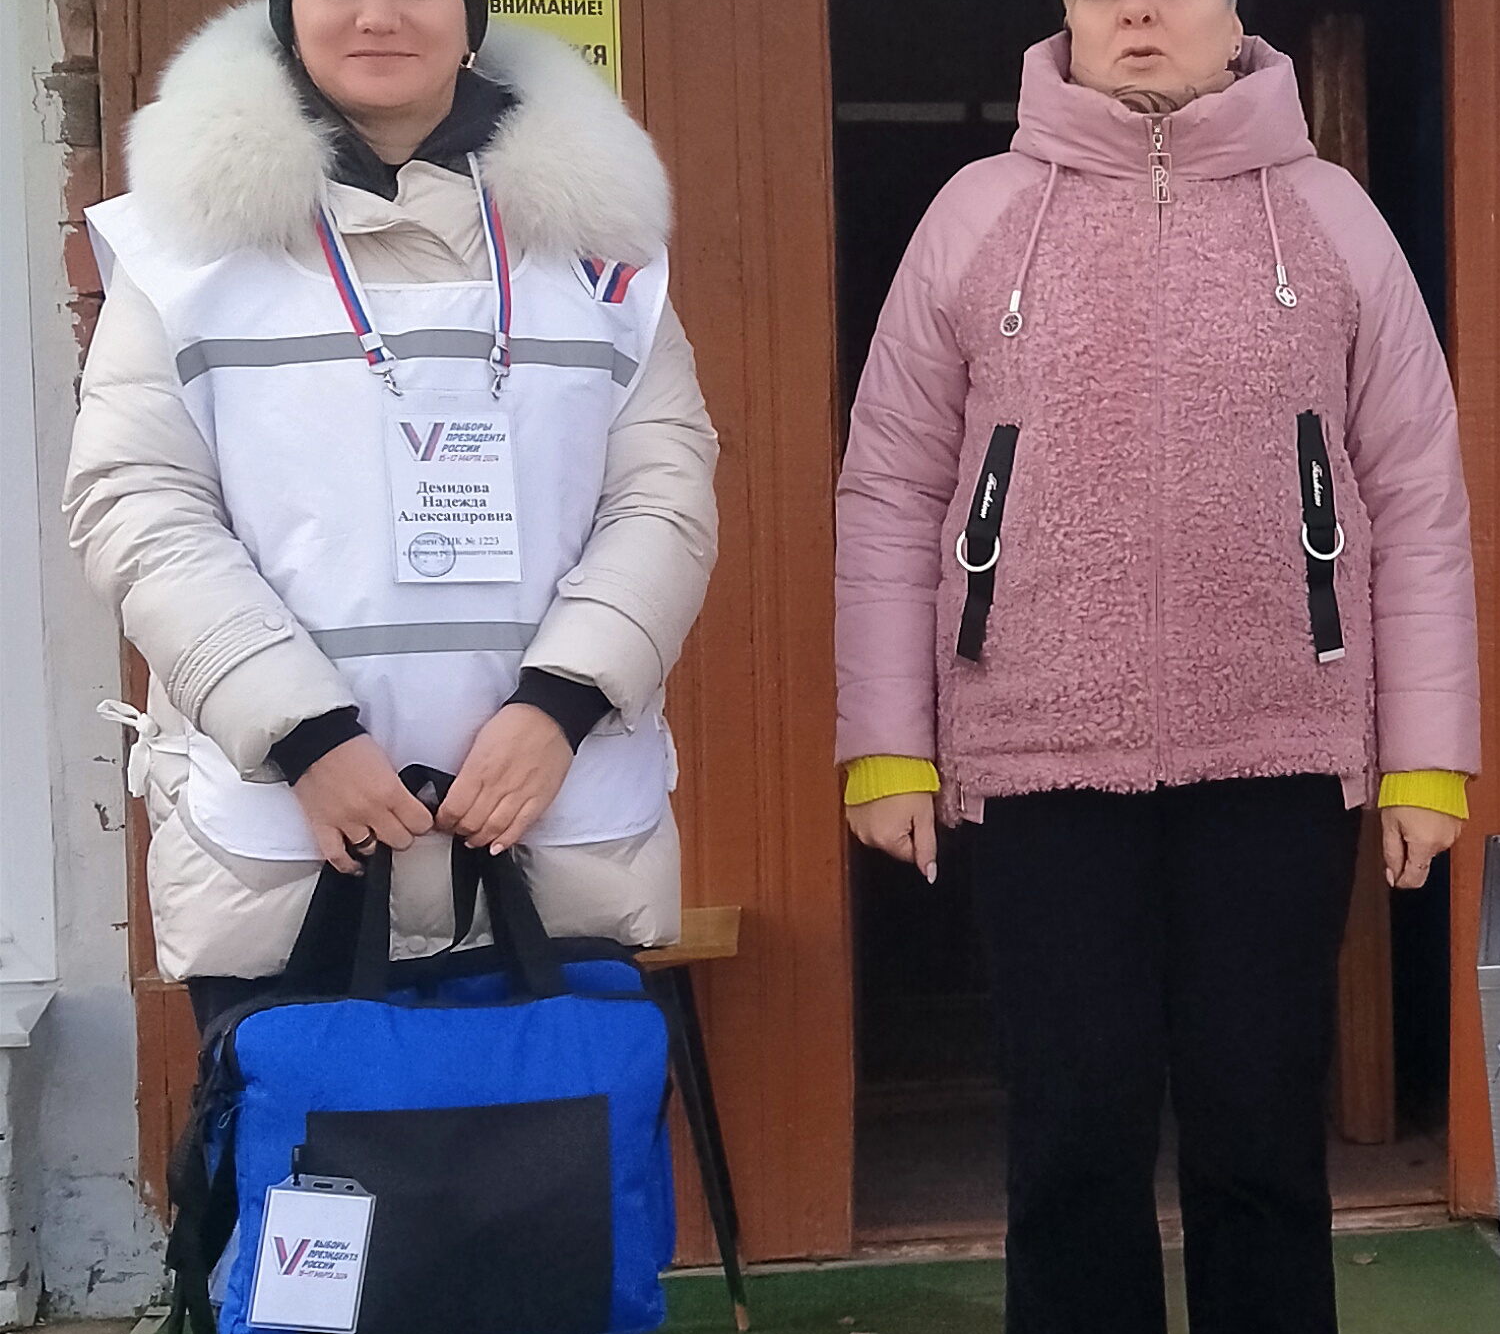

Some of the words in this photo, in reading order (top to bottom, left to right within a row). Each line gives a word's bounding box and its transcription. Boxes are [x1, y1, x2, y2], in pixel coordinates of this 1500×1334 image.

[449, 422, 493, 431] ВЫБОРЫ
[446, 433, 506, 442] ПРЕЗИДЕНТА
[441, 444, 481, 453] РОССИИ
[416, 481, 490, 495] Демидова
[422, 496, 487, 509] Надежда
[398, 510, 513, 525] Александровна
[479, 536, 500, 546] 1223
